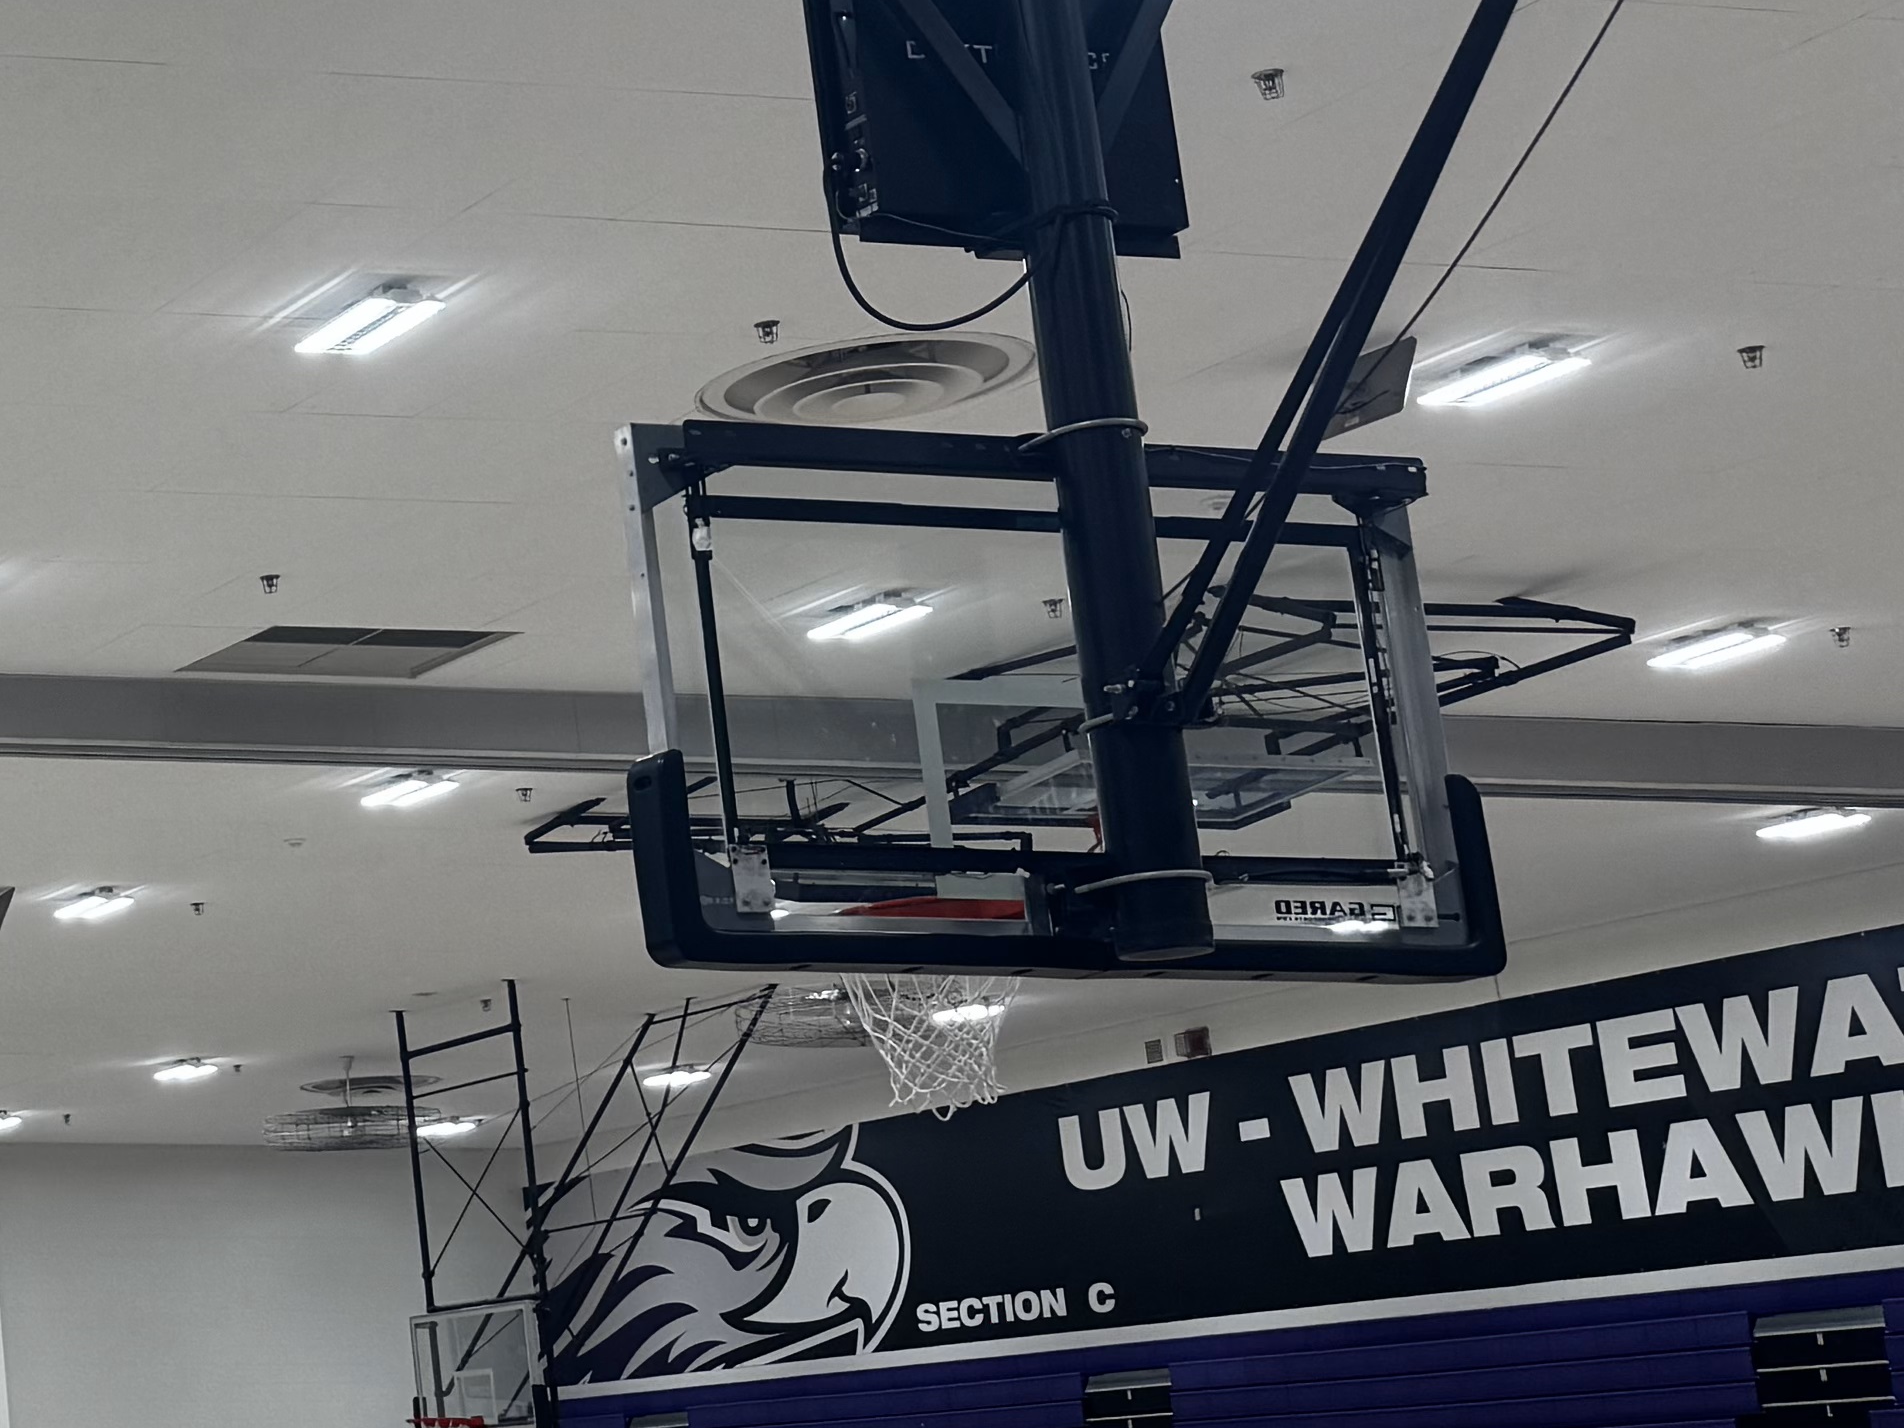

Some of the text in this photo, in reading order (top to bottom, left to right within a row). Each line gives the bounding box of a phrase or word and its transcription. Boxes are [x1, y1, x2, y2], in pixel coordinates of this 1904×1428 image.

[1057, 1091, 1211, 1192] UW
[1287, 967, 1904, 1154] WHITEWA
[916, 1282, 1116, 1332] SECTION C
[1826, 1404, 1833, 1417] L
